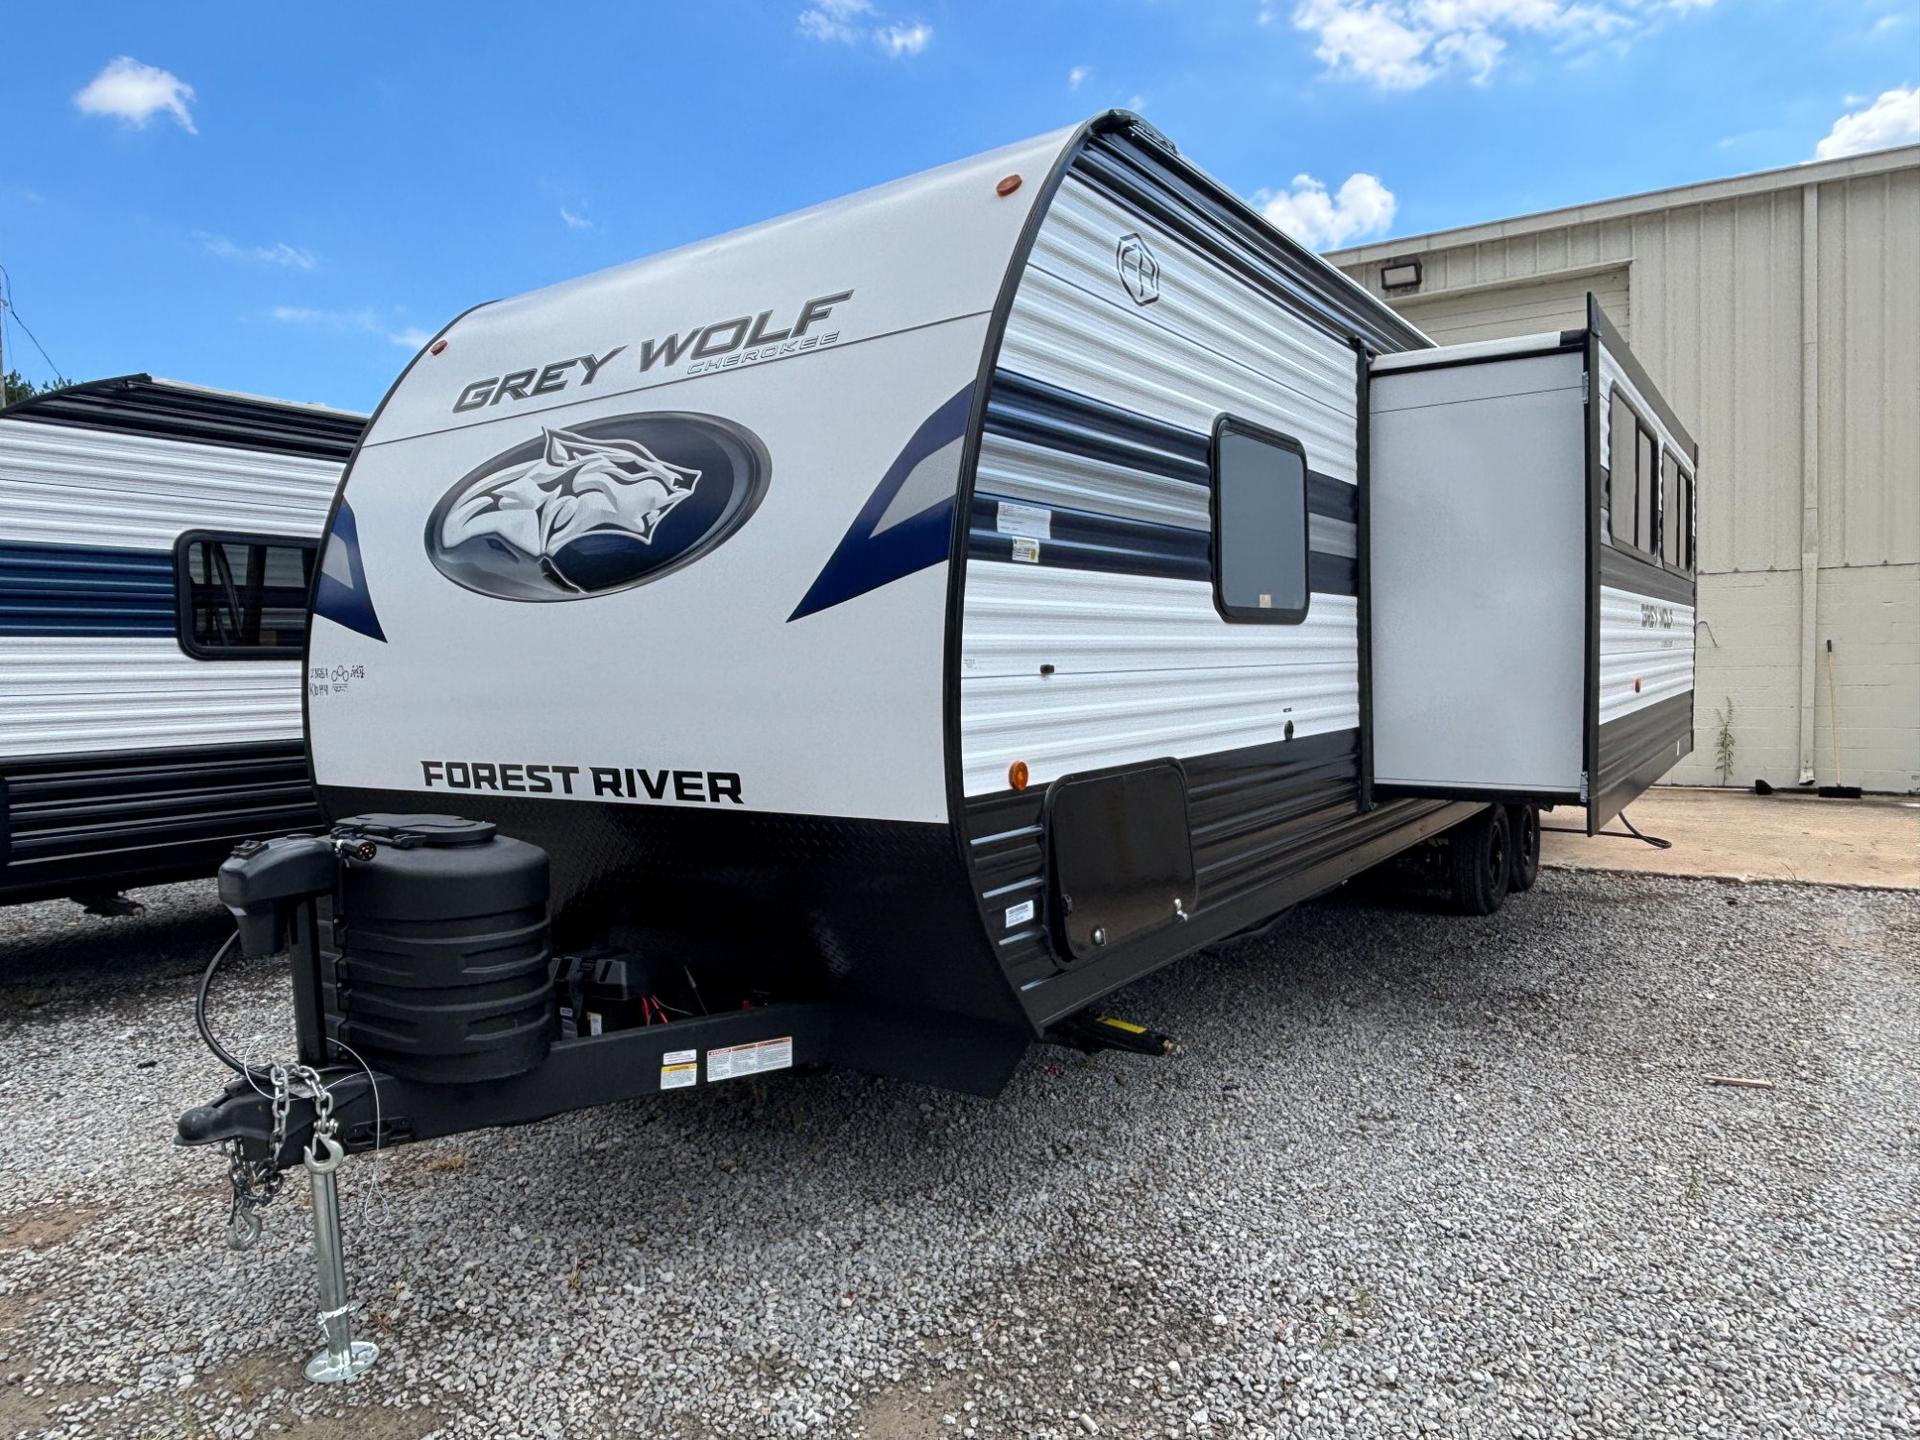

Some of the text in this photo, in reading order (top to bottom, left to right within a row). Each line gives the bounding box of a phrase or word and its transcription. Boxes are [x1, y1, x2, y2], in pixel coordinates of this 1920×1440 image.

[452, 289, 855, 414] GREY WOLF
[687, 330, 840, 375] CHEROKEE
[420, 760, 745, 804] FOREST RIVER
